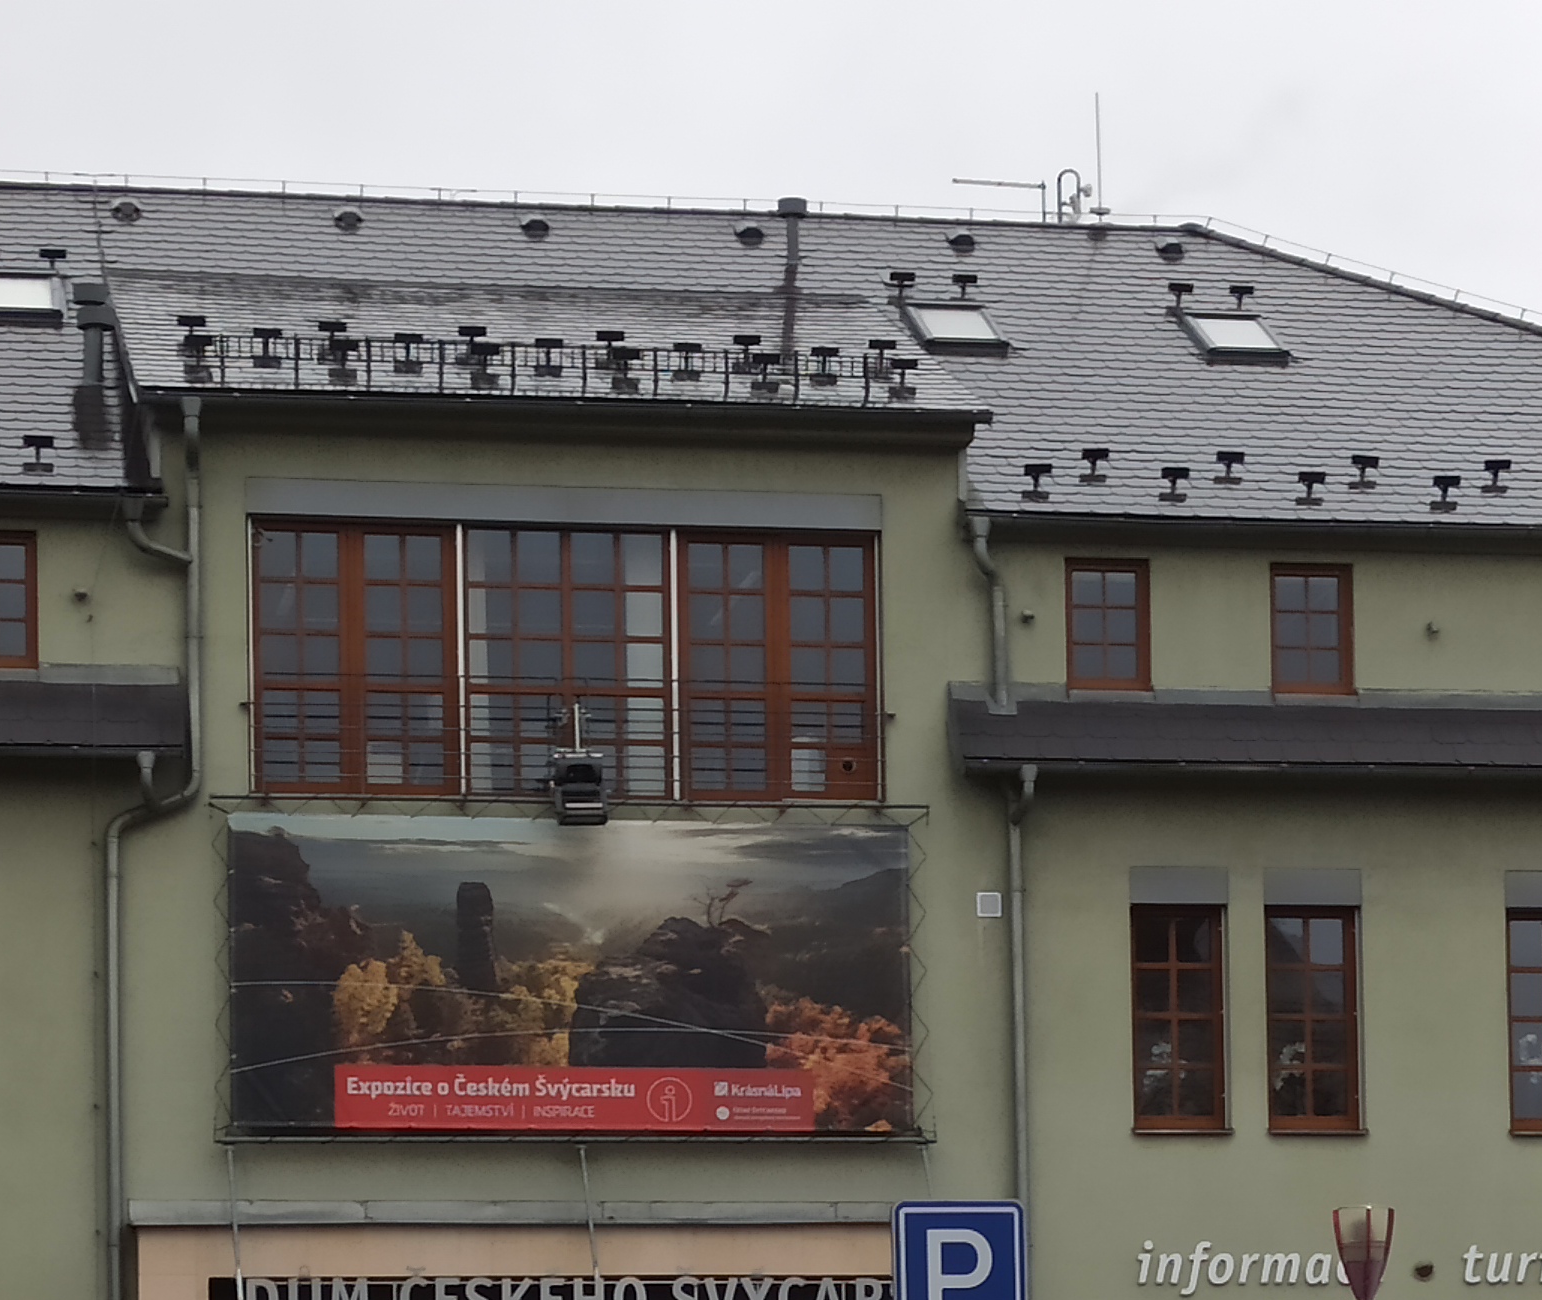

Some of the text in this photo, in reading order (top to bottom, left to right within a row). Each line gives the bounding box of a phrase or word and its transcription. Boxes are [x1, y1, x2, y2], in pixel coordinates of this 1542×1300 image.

[346, 1074, 636, 1100] Expozice o Českém Švýcarsku
[387, 1102, 595, 1118] ŽIVOT TAJEMSTVÍ INSPIRACE
[1136, 1240, 1352, 1296] informa
